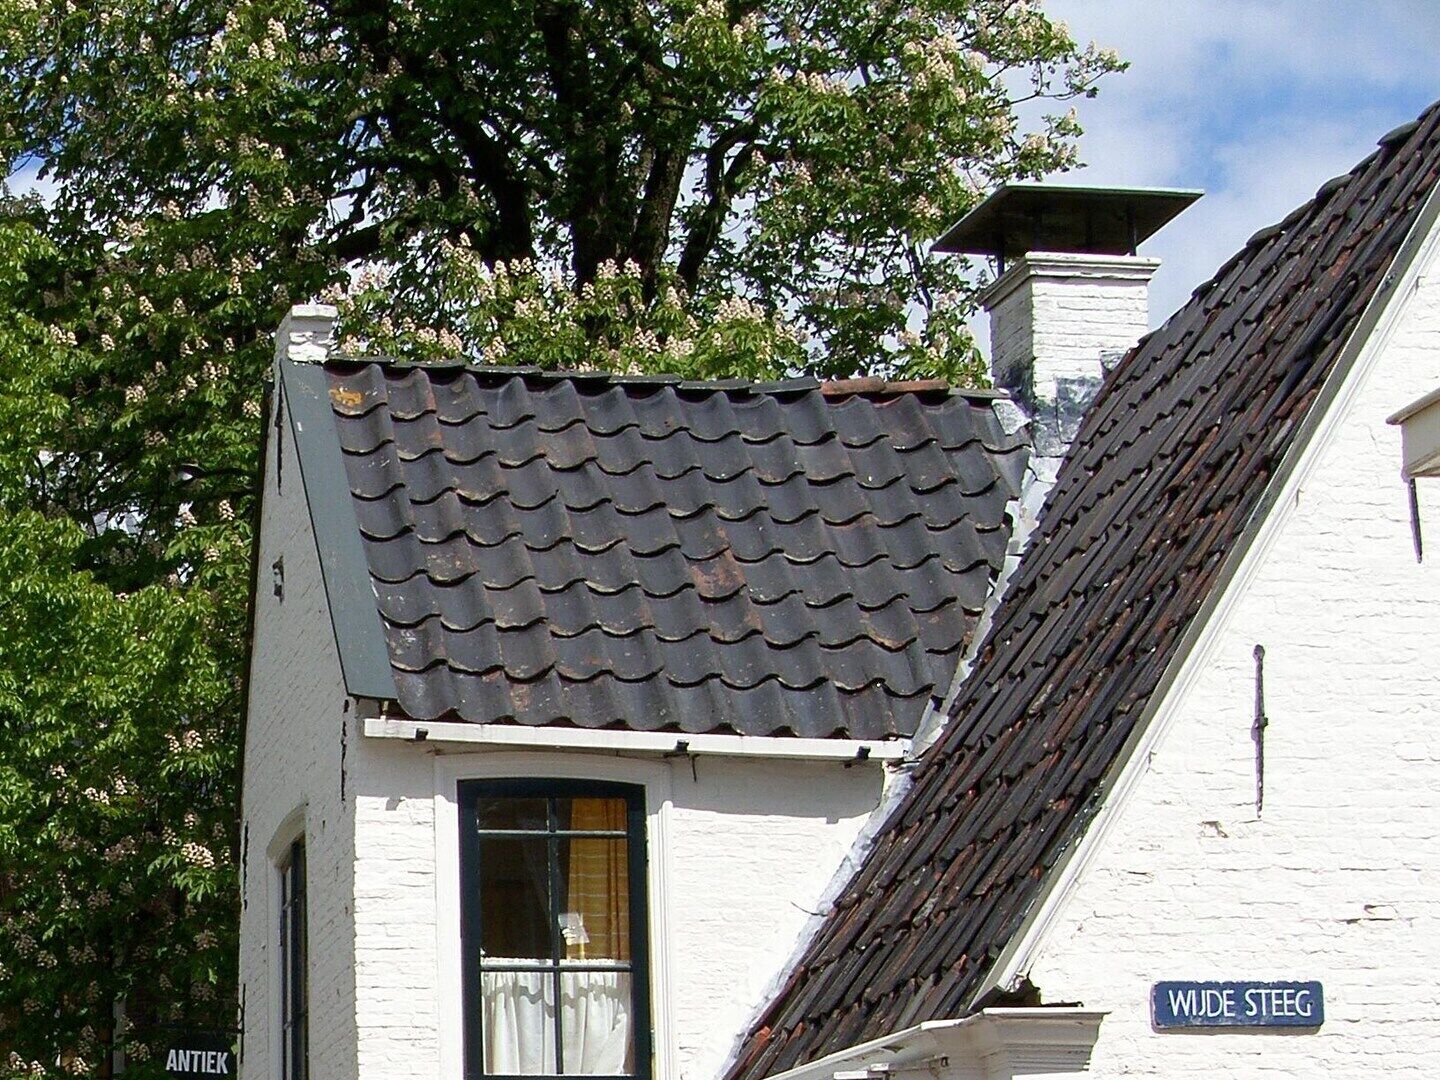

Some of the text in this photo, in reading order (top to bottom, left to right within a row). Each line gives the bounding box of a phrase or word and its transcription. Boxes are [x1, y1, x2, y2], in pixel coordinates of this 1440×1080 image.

[1168, 989, 1313, 1018] WIJDE STEEG
[165, 1048, 229, 1075] ANTIEK
